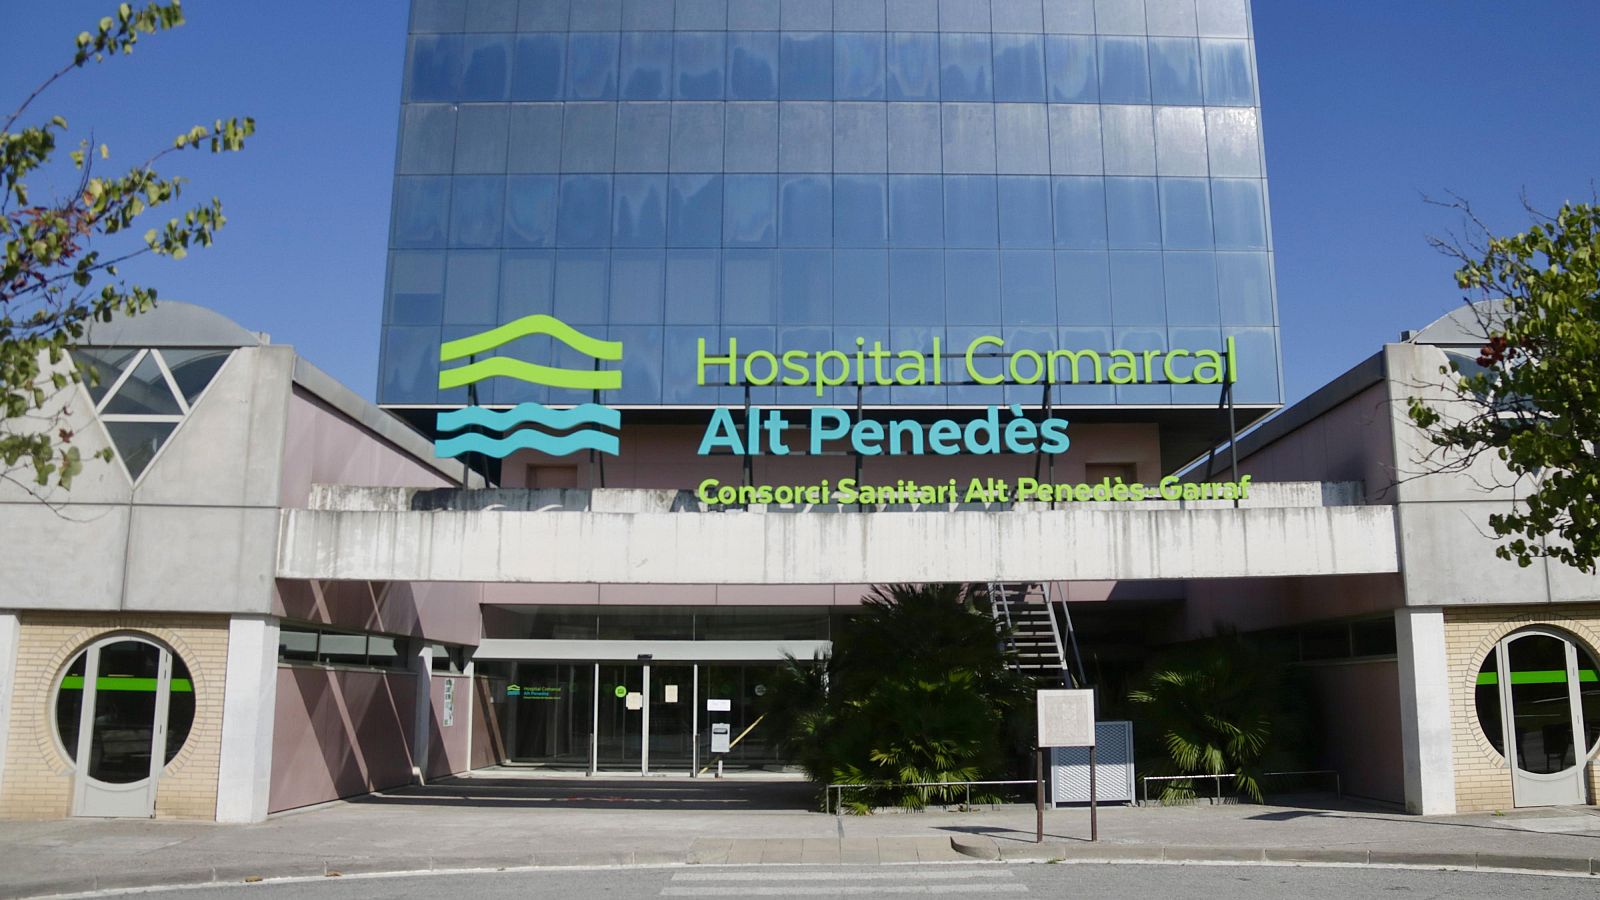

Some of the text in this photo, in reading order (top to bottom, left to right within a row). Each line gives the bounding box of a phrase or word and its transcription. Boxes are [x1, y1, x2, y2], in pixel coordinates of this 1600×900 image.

[697, 335, 1237, 396] Hospital Comarcal
[697, 403, 1070, 456] Alt Penedès
[697, 474, 1253, 506] Consorci Sanitari Alt Penedès-Garraf
